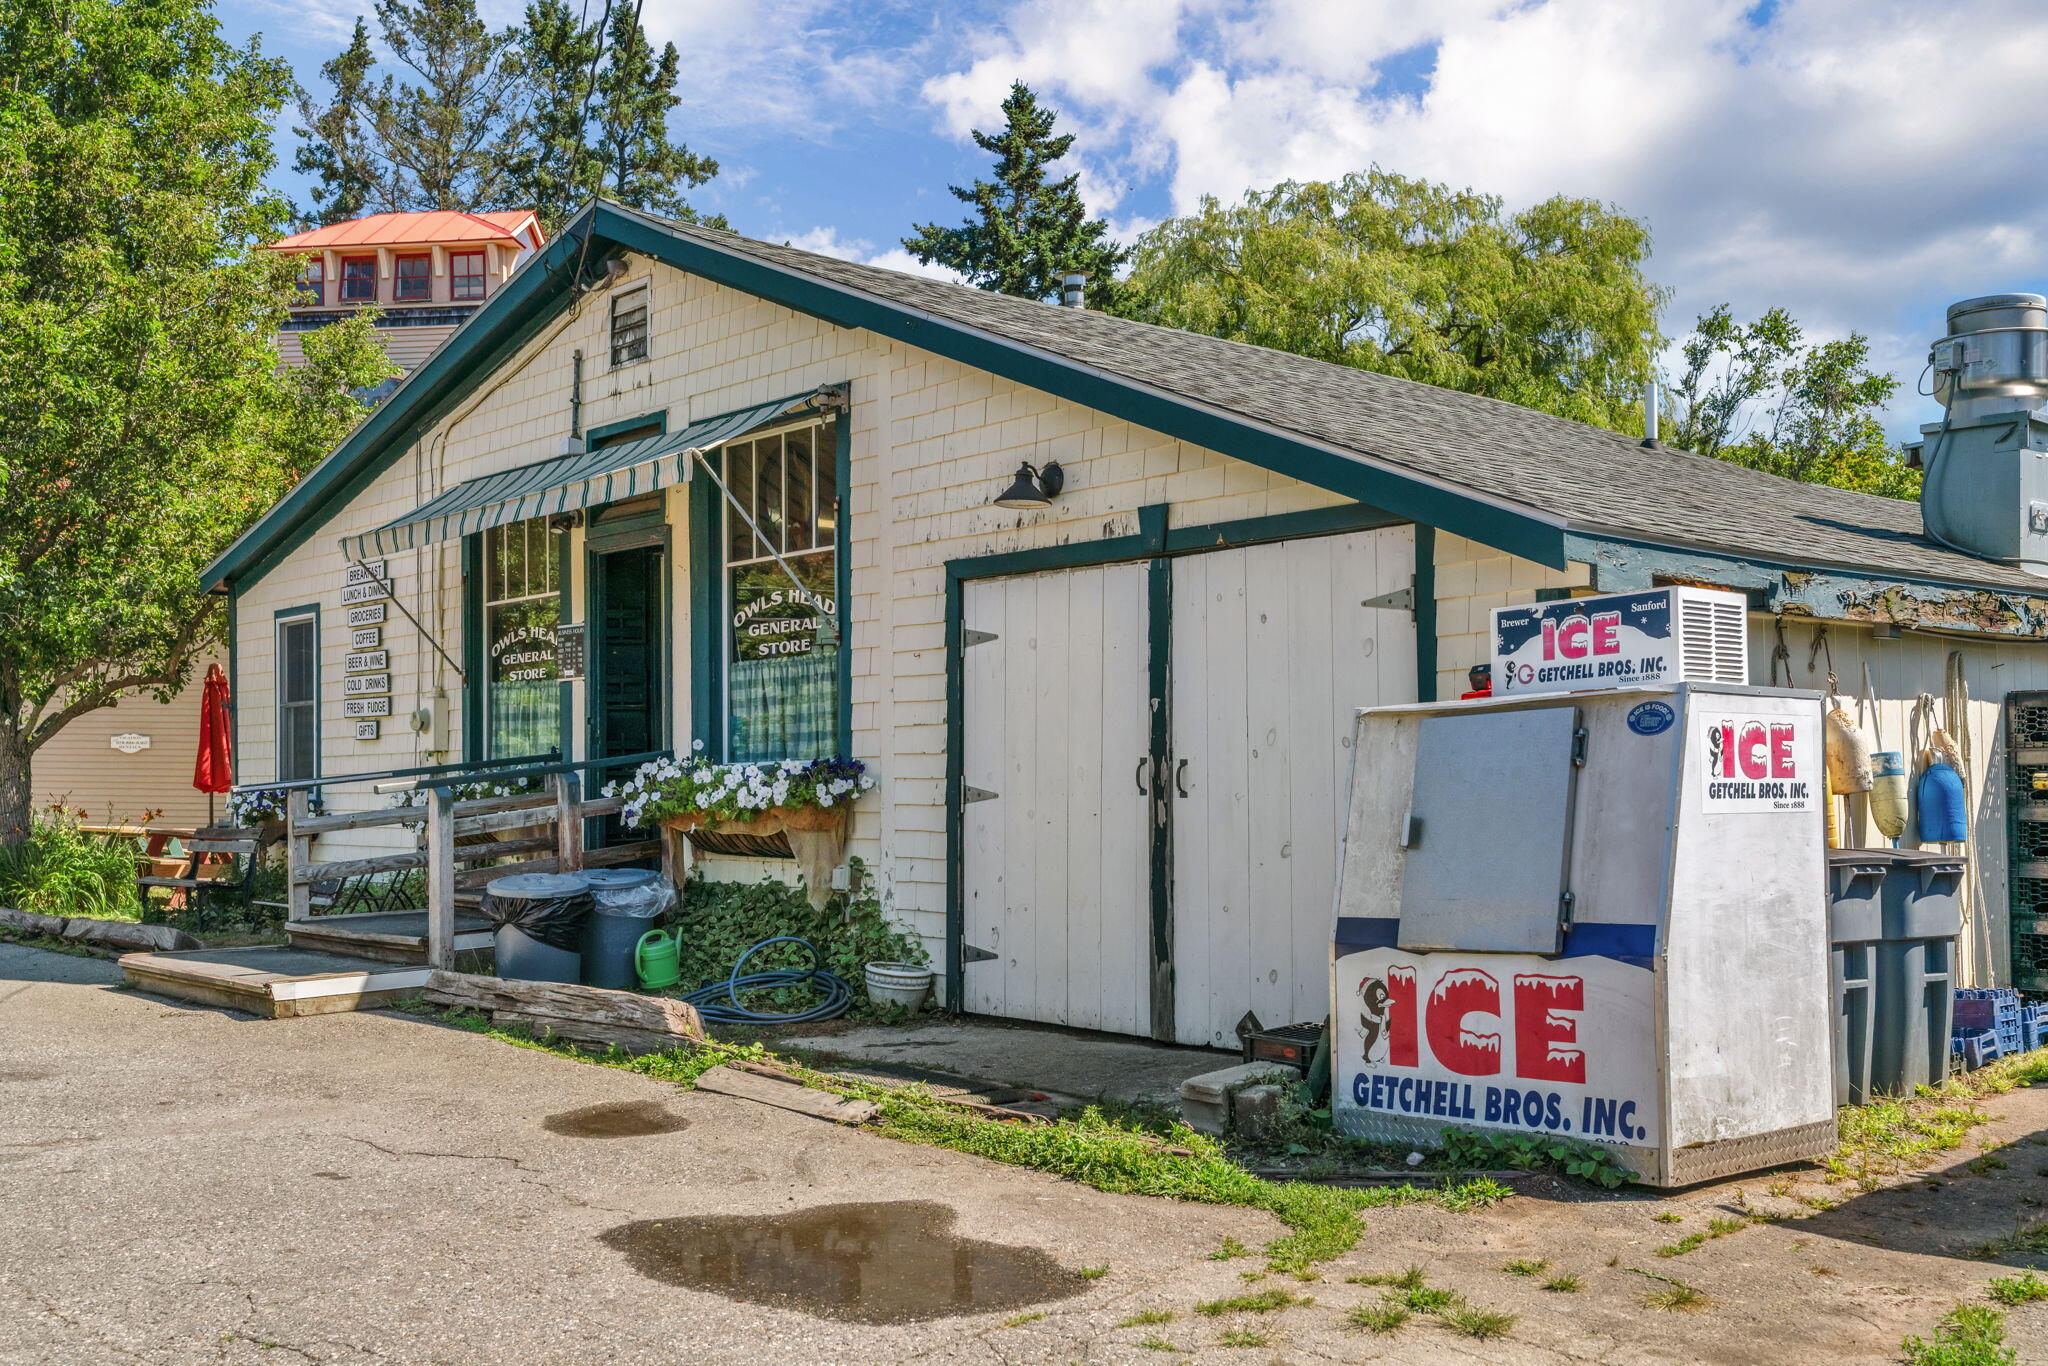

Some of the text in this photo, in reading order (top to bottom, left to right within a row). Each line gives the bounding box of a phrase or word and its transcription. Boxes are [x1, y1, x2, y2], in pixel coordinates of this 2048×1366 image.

[344, 588, 362, 602] LUNCH
[363, 586, 367, 598] &
[734, 589, 836, 628] OWLS HEAD
[1631, 599, 1667, 612] Sanford
[350, 608, 382, 623] GROCERIES
[1500, 618, 1530, 628] Brewer
[748, 617, 822, 636] GENERAL
[355, 632, 376, 645] COFFEE
[491, 627, 527, 658] OWLS
[530, 626, 558, 646] HEA
[1541, 611, 1621, 661] ICE
[758, 638, 811, 656] STORE
[348, 654, 384, 668] BEER & WINE
[502, 649, 554, 666] GENERAL
[509, 668, 547, 682] STORE
[1538, 662, 1594, 683] GETCHELL
[1640, 656, 1668, 674] INC.
[346, 677, 386, 691] COLD DRINKS
[1618, 673, 1661, 684] Since 1888
[346, 700, 386, 714] FRESH FUDGE
[358, 724, 374, 736] GIFTS
[1721, 719, 1796, 780] ICE
[1709, 782, 1809, 800] GETCHELL BROS. INC.
[1773, 801, 1790, 809] Since
[1387, 964, 1586, 1084] ICE
[1352, 1072, 1647, 1140] GETCHELL BROS. INC.
